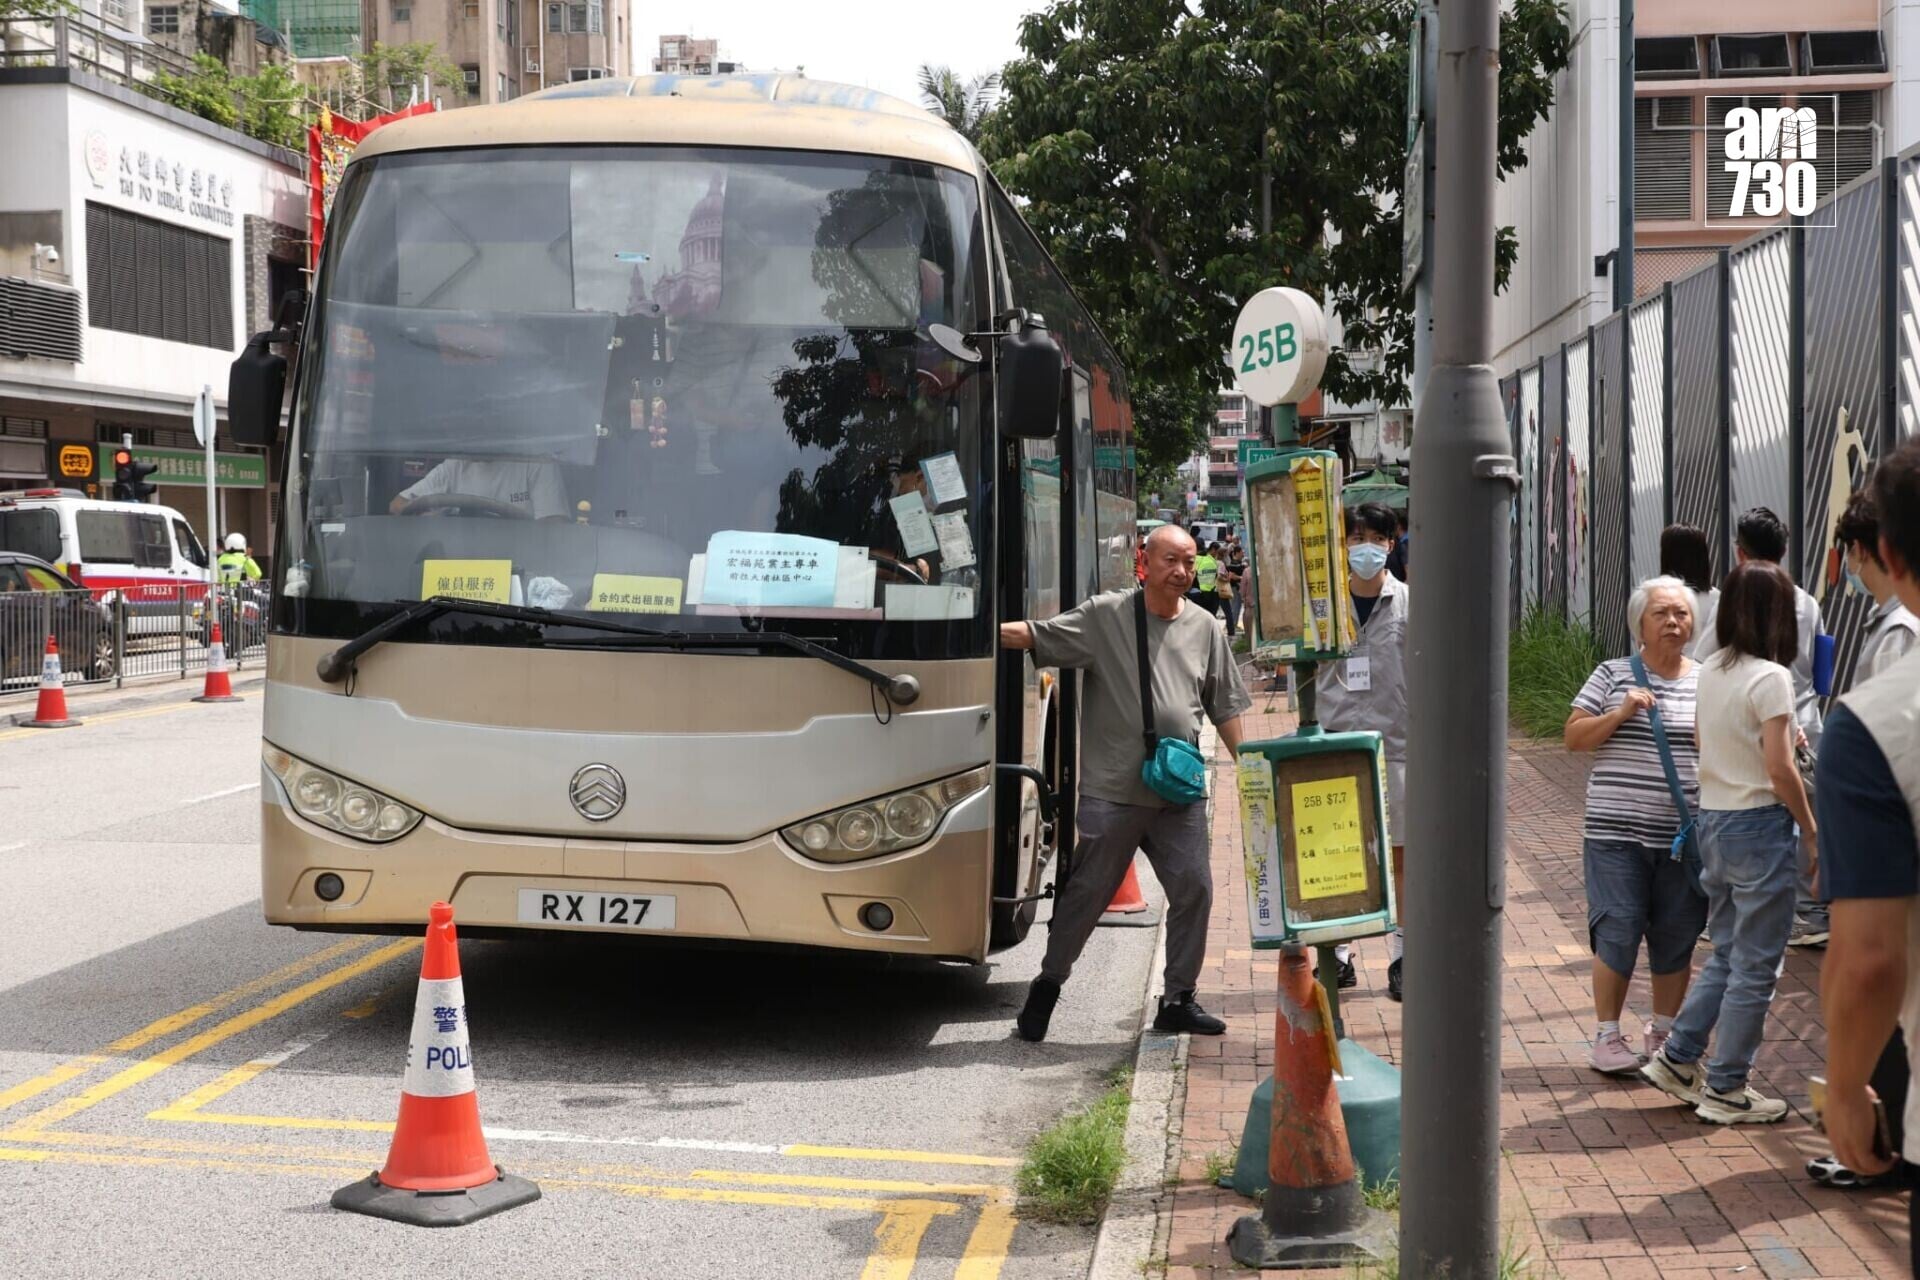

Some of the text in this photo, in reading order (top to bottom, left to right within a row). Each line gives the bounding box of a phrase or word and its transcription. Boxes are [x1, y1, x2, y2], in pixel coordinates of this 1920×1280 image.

[120, 177, 234, 227] TAI PO RURAL COMMITTEE
[1239, 322, 1297, 374] 25B
[599, 592, 675, 606] 合約式出租服務
[1304, 791, 1347, 808] 25B $7.7
[541, 893, 652, 925] RX 127
